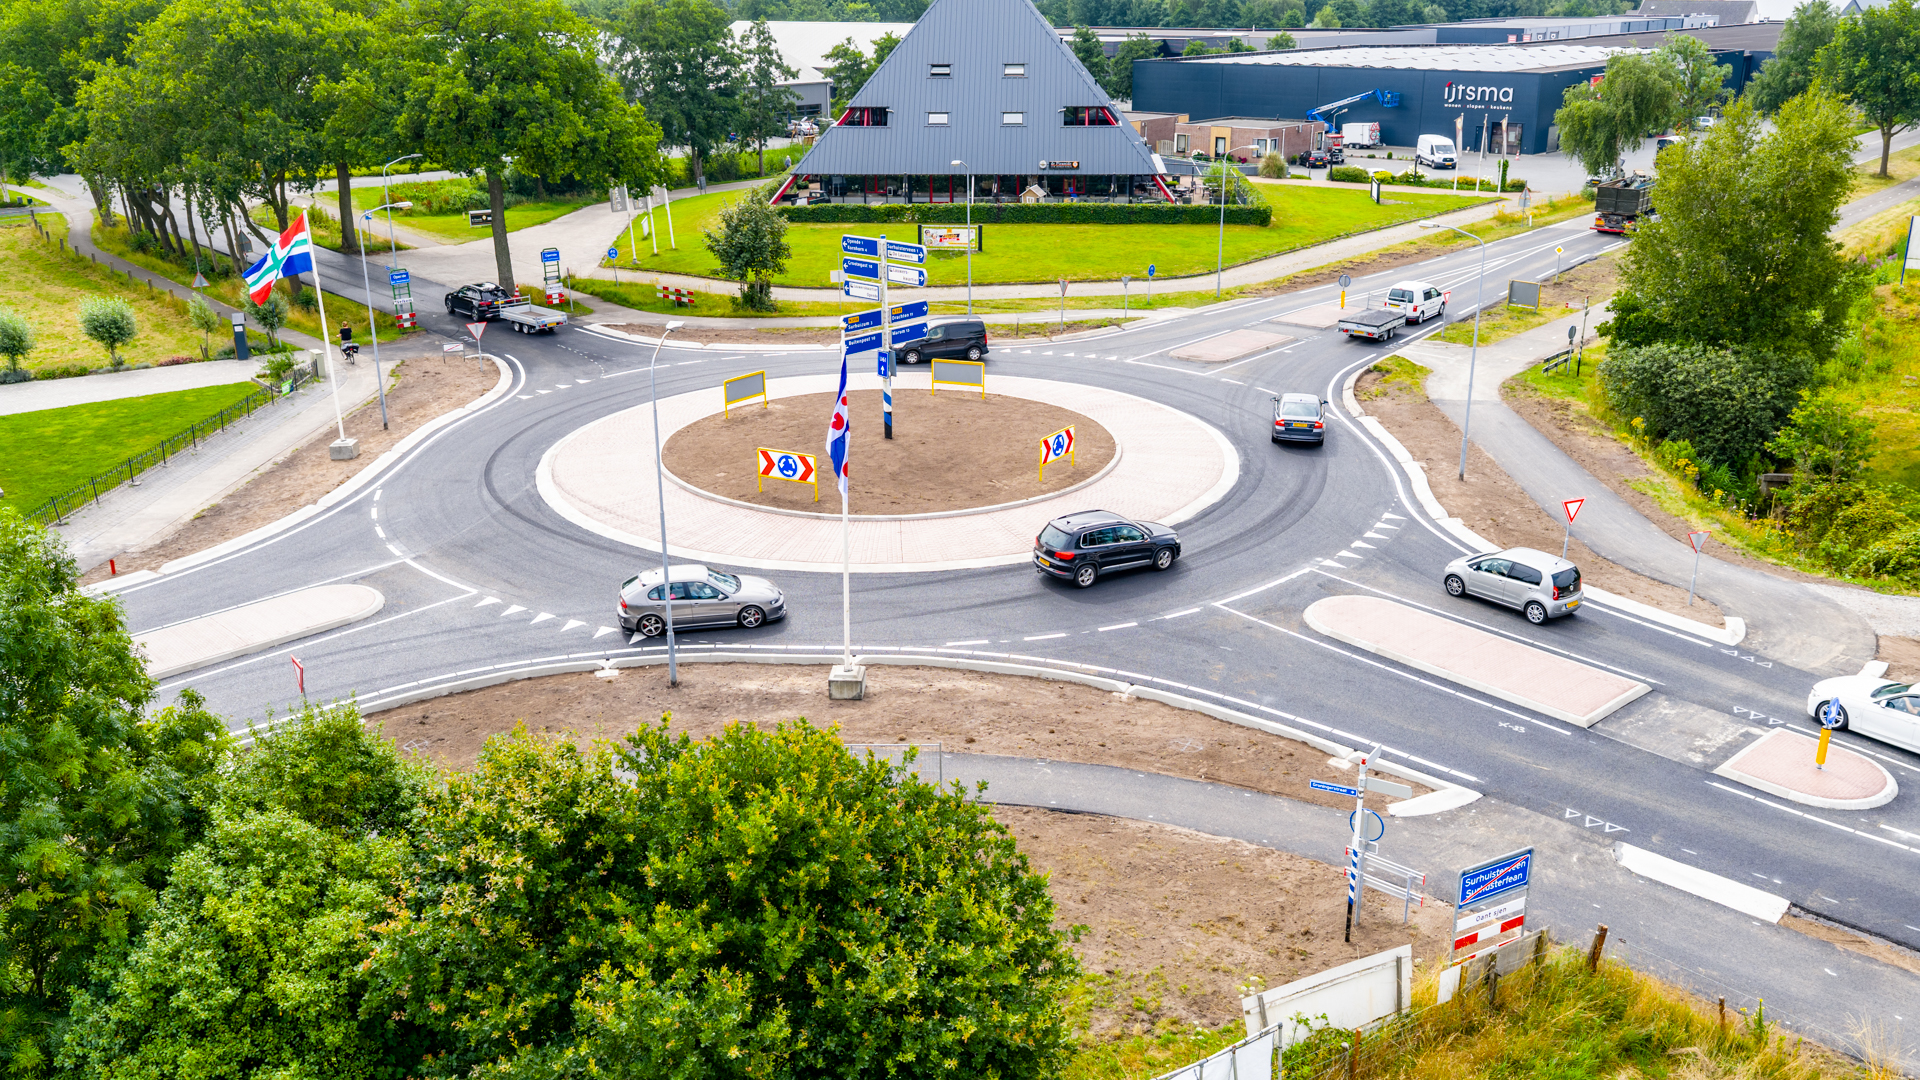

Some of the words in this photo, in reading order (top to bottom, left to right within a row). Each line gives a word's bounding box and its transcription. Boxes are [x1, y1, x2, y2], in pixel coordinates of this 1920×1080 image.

[1444, 81, 1514, 103] ijtsma
[887, 244, 916, 253] Surhuisterveen
[847, 260, 868, 268] Grootegast
[848, 321, 870, 330] Surhuizum
[849, 337, 871, 346] Buitenpost
[1464, 860, 1526, 887] Surhuisterveen
[1465, 872, 1523, 898] Surhusterfean
[1475, 912, 1492, 922] Oant
[1493, 907, 1507, 917] sjen
